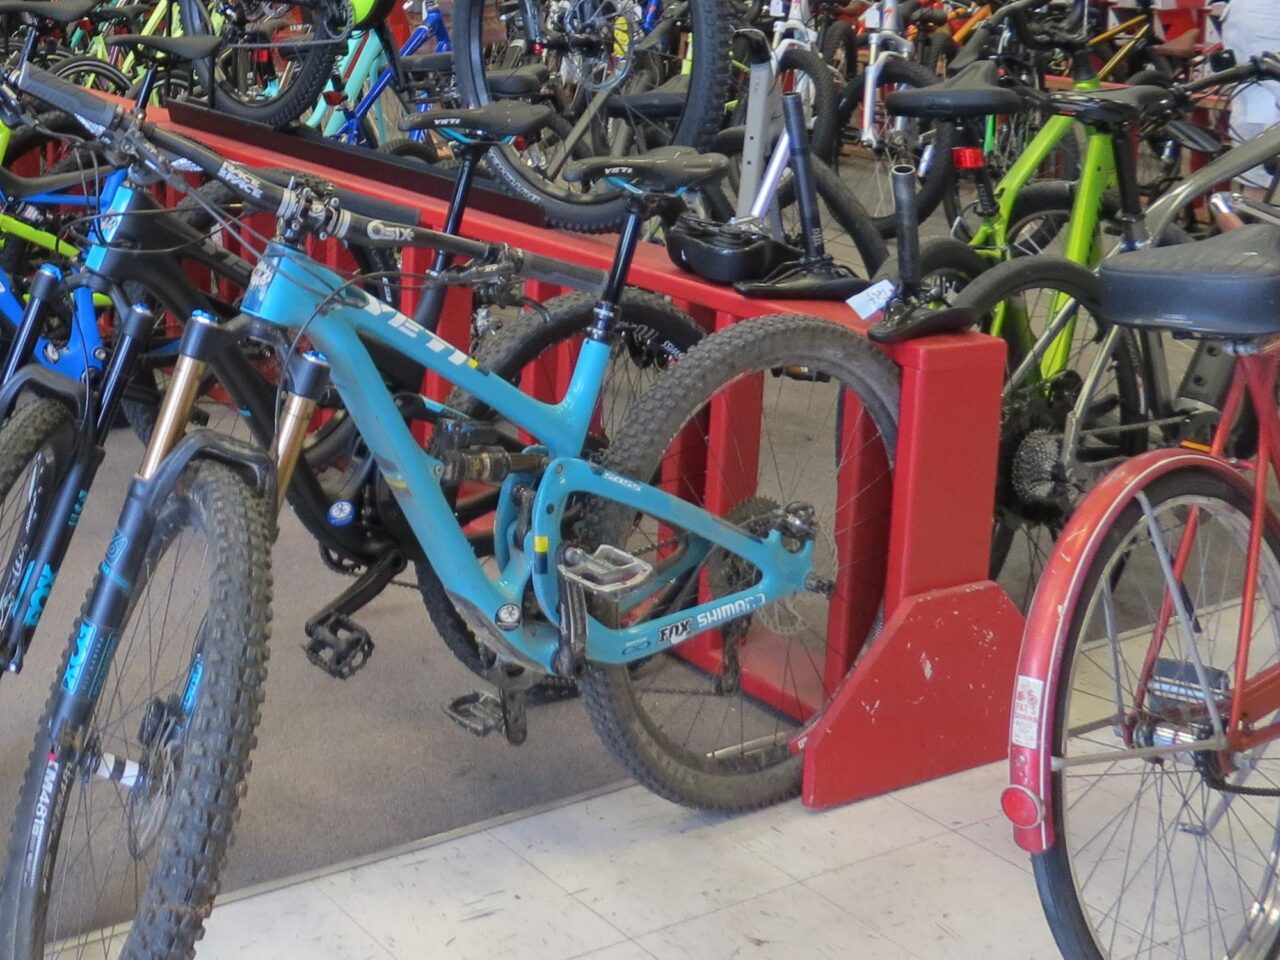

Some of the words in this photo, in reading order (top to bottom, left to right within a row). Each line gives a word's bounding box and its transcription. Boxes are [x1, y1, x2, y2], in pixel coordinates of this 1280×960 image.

[433, 118, 461, 126] YETI
[604, 166, 634, 175] YETI
[363, 290, 469, 366] YETI
[658, 617, 692, 643] FOX
